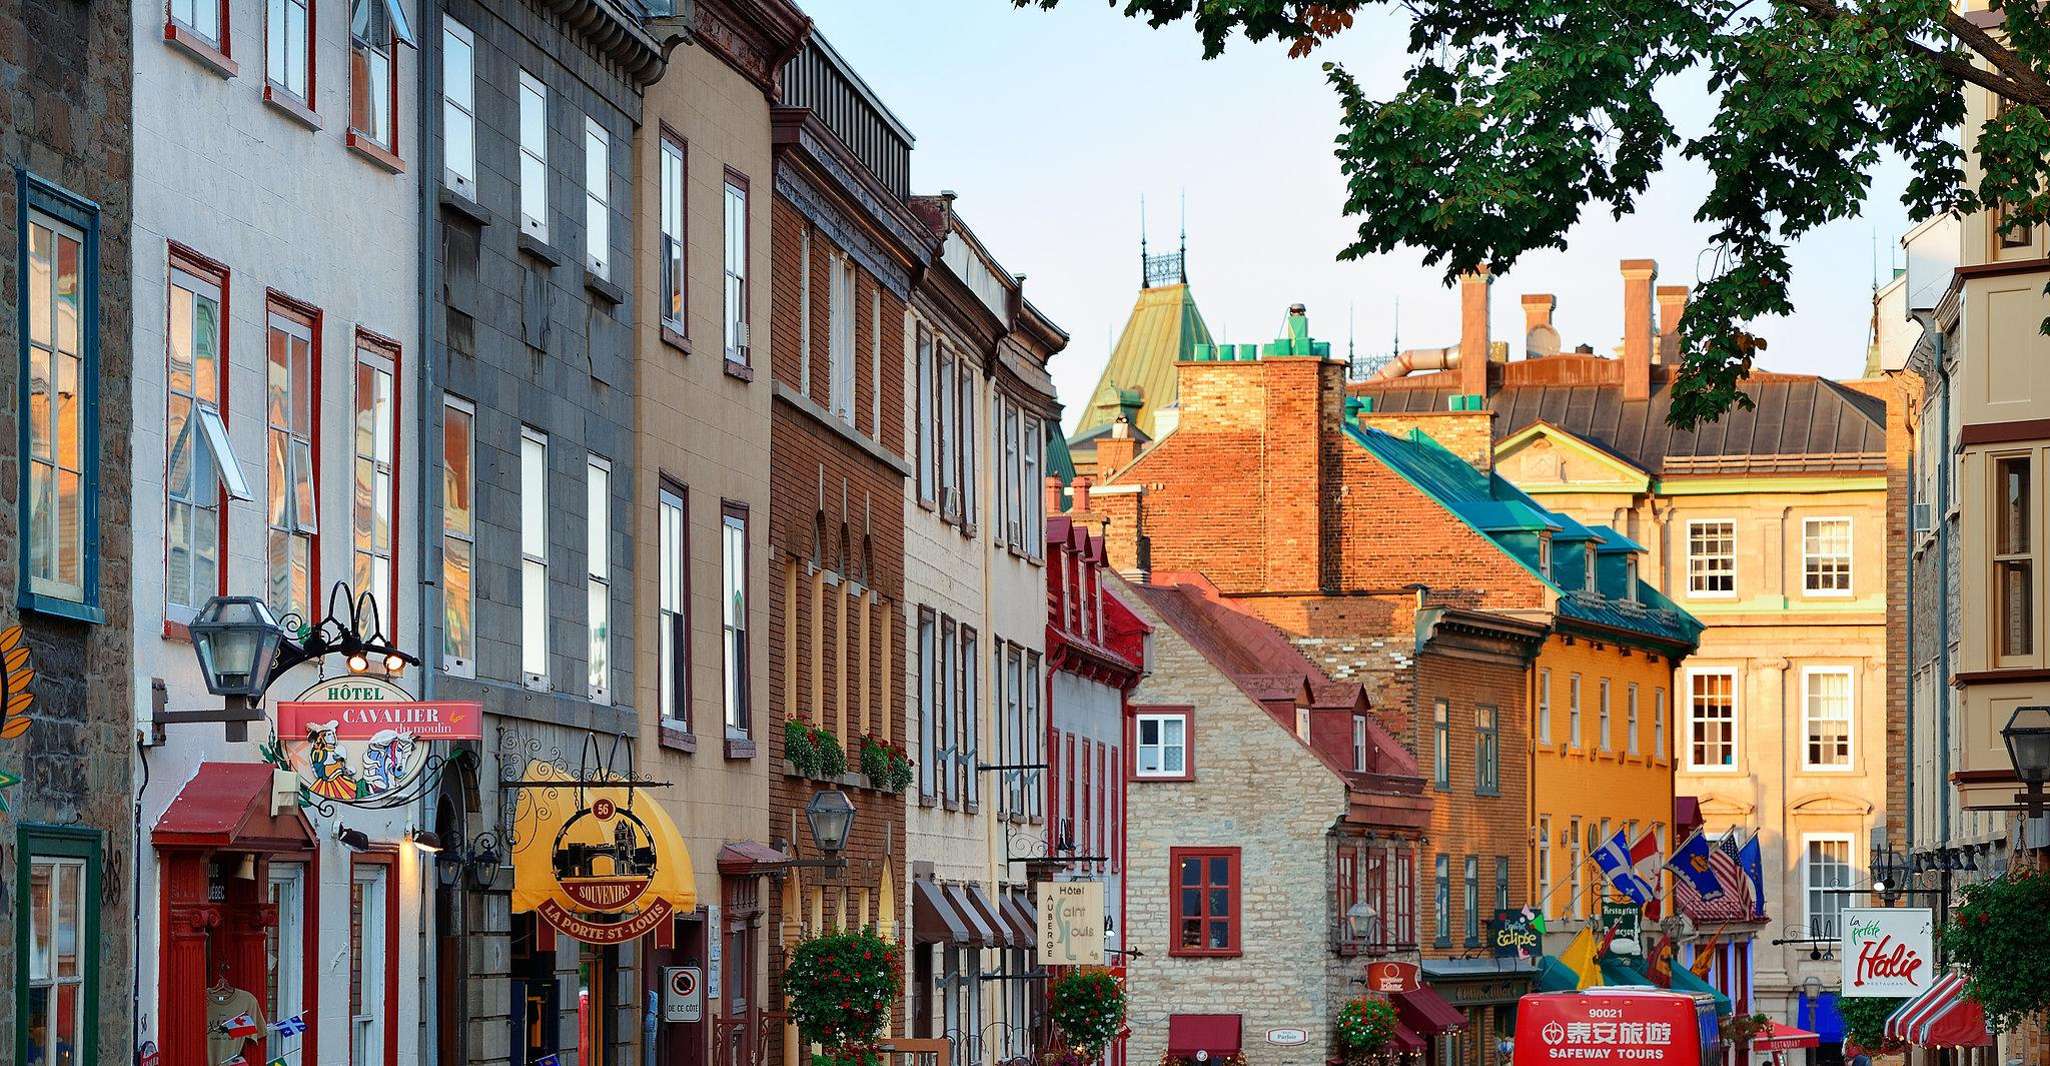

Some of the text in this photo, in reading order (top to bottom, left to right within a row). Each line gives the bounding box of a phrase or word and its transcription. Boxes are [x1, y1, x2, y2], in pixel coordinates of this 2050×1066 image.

[328, 684, 384, 700] HÔTEL
[343, 708, 439, 723] CAVALIER
[413, 723, 452, 733] moulin
[597, 803, 609, 815] 56
[579, 885, 631, 905] SOUVENIRS
[1059, 886, 1085, 895] Hôtel
[544, 904, 562, 923] LA
[561, 919, 605, 940] PORTE
[1046, 894, 1054, 958] AUBERGE
[1852, 920, 1881, 946] petite
[1853, 934, 1922, 987] Italie
[668, 1004, 675, 1013] DE
[676, 1004, 684, 1013] CE
[1588, 1008, 1623, 1018] 90021
[1566, 1021, 1672, 1045] 泰安旅遊
[1549, 1048, 1664, 1059] SAFEWAY TOURS
